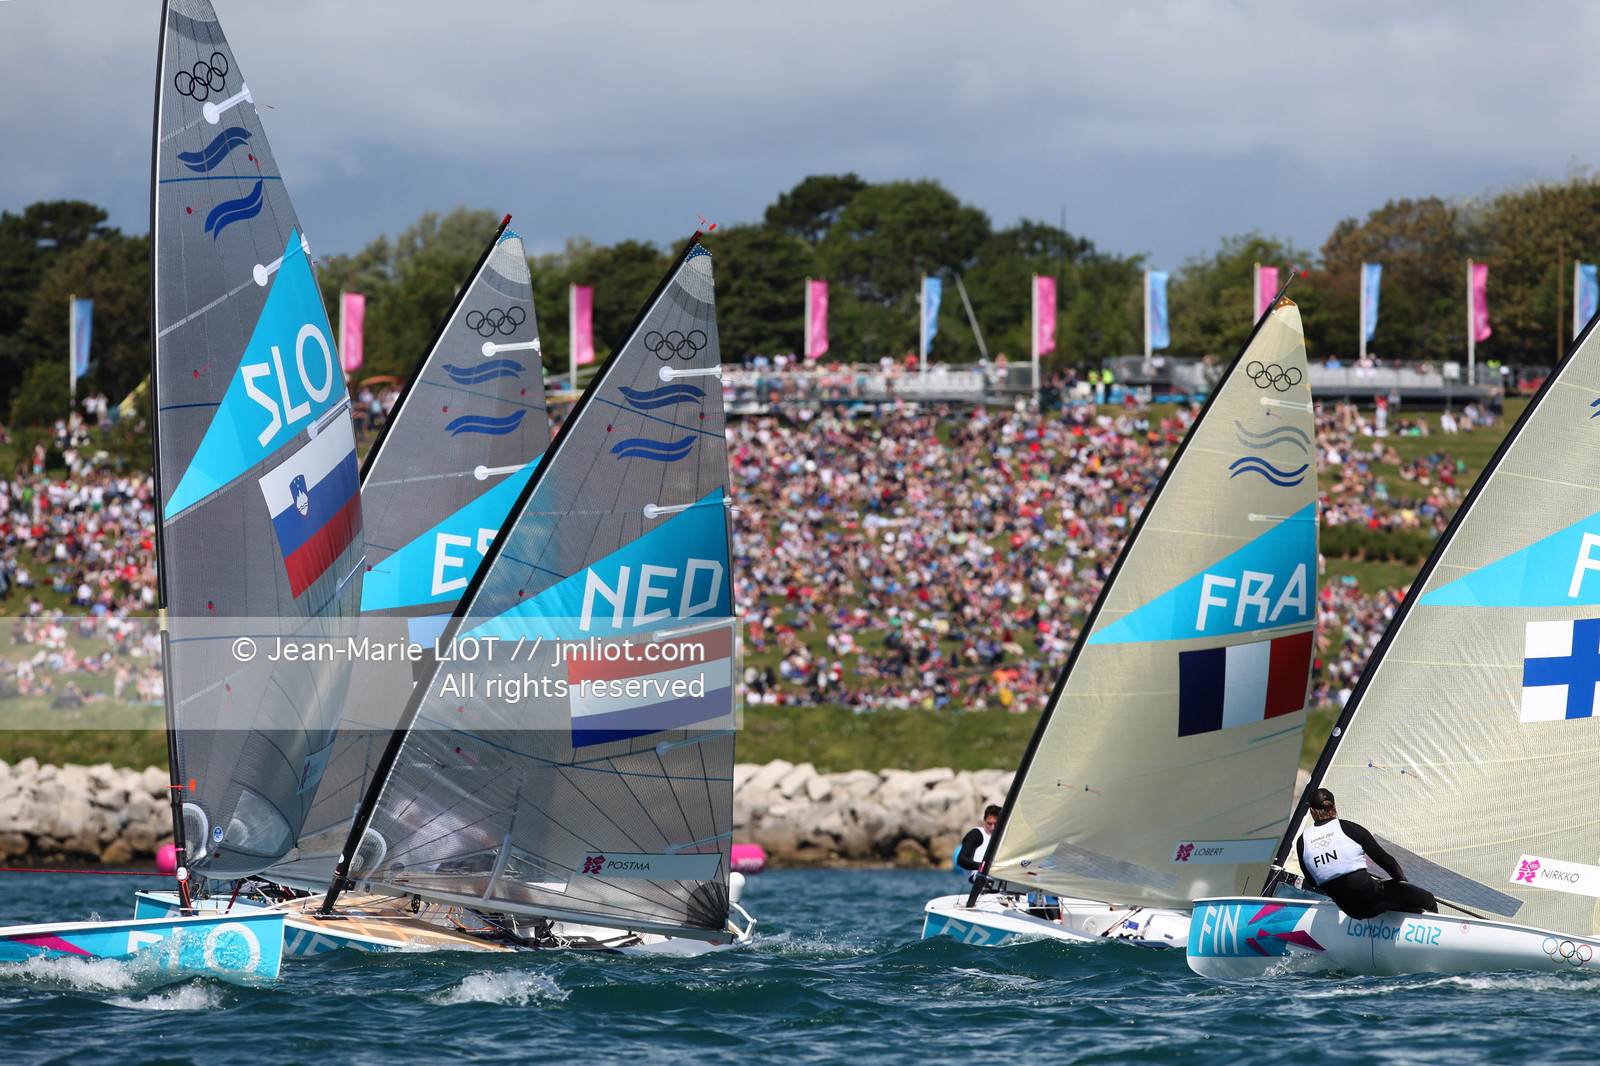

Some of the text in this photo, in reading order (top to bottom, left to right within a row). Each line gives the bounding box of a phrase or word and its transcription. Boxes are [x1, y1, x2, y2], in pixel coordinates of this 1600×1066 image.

[241, 323, 333, 448] SLO
[579, 558, 724, 632] NED
[1195, 563, 1307, 632] FRA
[606, 860, 650, 871] POSTMA
[1194, 847, 1225, 857] LOBERT
[1313, 849, 1339, 868] FIN
[1540, 868, 1580, 884] NIRKKO
[1198, 903, 1242, 955] FIN
[1346, 917, 1401, 942] London
[1404, 922, 1443, 946] 2012
